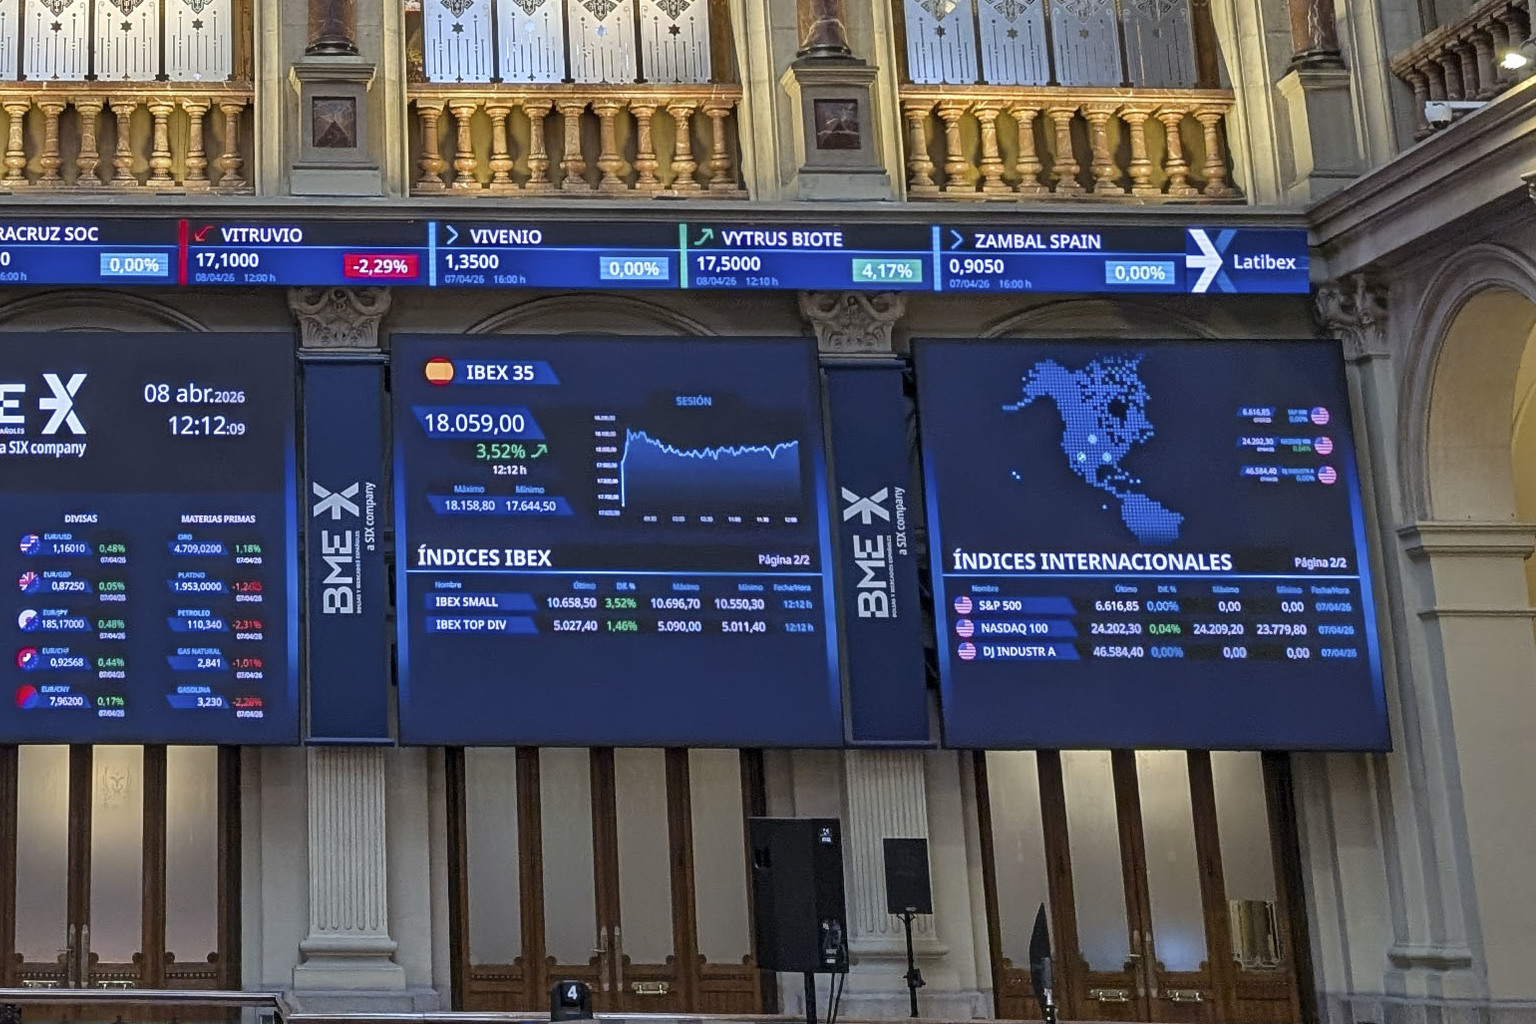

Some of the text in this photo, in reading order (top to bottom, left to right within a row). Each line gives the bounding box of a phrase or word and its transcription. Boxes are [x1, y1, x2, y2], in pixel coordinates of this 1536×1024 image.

[64, 227, 99, 241] SOC
[222, 228, 302, 242] VITRUVIO
[470, 230, 542, 244] VIVENIO
[722, 231, 842, 247] VYTRUS BIOTE
[975, 234, 1101, 249] ZAMBAL SPAIN
[110, 258, 159, 273] 0,00%
[196, 253, 259, 269] 17,1000
[445, 254, 498, 270] 1,3500
[697, 256, 760, 272] 17,5000
[950, 259, 1004, 275] 0,9050
[1234, 254, 1296, 270] Latibex
[353, 260, 408, 275] -2,29%
[609, 262, 659, 277] 0,00%
[862, 264, 912, 280] 4,17%
[1116, 266, 1165, 282] 0,00%
[466, 365, 534, 380] IBEX 35
[144, 384, 170, 403] 08
[676, 395, 712, 406] SESIÓN
[169, 415, 245, 435] 12:12:09
[425, 414, 524, 435] 18.059,00
[0, 441, 86, 457] a SIX company
[476, 444, 525, 460] 3,52%
[493, 465, 527, 475] 12:12 h
[365, 482, 376, 525] company
[445, 500, 495, 512] 18.158,80
[506, 501, 556, 513] 17.644,50
[895, 487, 906, 530] company
[65, 515, 97, 523] DIVISAS
[182, 515, 256, 523] MATERIAS PRIMAS
[365, 527, 374, 543] SIX
[897, 532, 907, 547] SIX
[53, 544, 85, 553] 1,16010
[418, 544, 552, 566] ÍNDICES IBEX
[759, 554, 810, 567] Página 2/2
[953, 548, 1232, 570] ÍNDICES INTERNACIONALES
[1295, 557, 1347, 570] Página 2/2
[322, 530, 353, 614] BME
[853, 535, 889, 617] BME
[52, 582, 84, 591] 0,87250
[436, 597, 498, 607] IBEX SMALL
[547, 598, 597, 609] 10.658,50
[651, 598, 700, 610] 10.696,70
[715, 599, 764, 610] 10.550,30
[979, 601, 1021, 611] S&P 500
[1096, 601, 1139, 612] 6.616,85
[1219, 602, 1241, 612] 0,00
[1282, 602, 1304, 612] 0,00
[42, 620, 84, 629] 185,17000
[188, 620, 222, 630] 110,340
[436, 620, 506, 630] IBEX TOP DIV
[554, 621, 598, 632] 5.027,40
[658, 621, 702, 632] 5.090,00
[722, 622, 766, 633] 5.011,40
[981, 623, 1048, 635] NASDAQ 100
[1091, 624, 1141, 635] 24.202,30
[1193, 624, 1244, 636] 24.209,20
[1257, 624, 1307, 636] 23.779,80
[983, 646, 1056, 658] DJ INDUSTR A
[1093, 647, 1143, 658] 46.584,40
[1223, 647, 1247, 659] 0,00
[1287, 648, 1310, 659] 0,00
[50, 658, 83, 668] 0,92568
[50, 697, 83, 706] 7,96200
[197, 698, 222, 707] 3,230
[568, 985, 577, 999] 4
